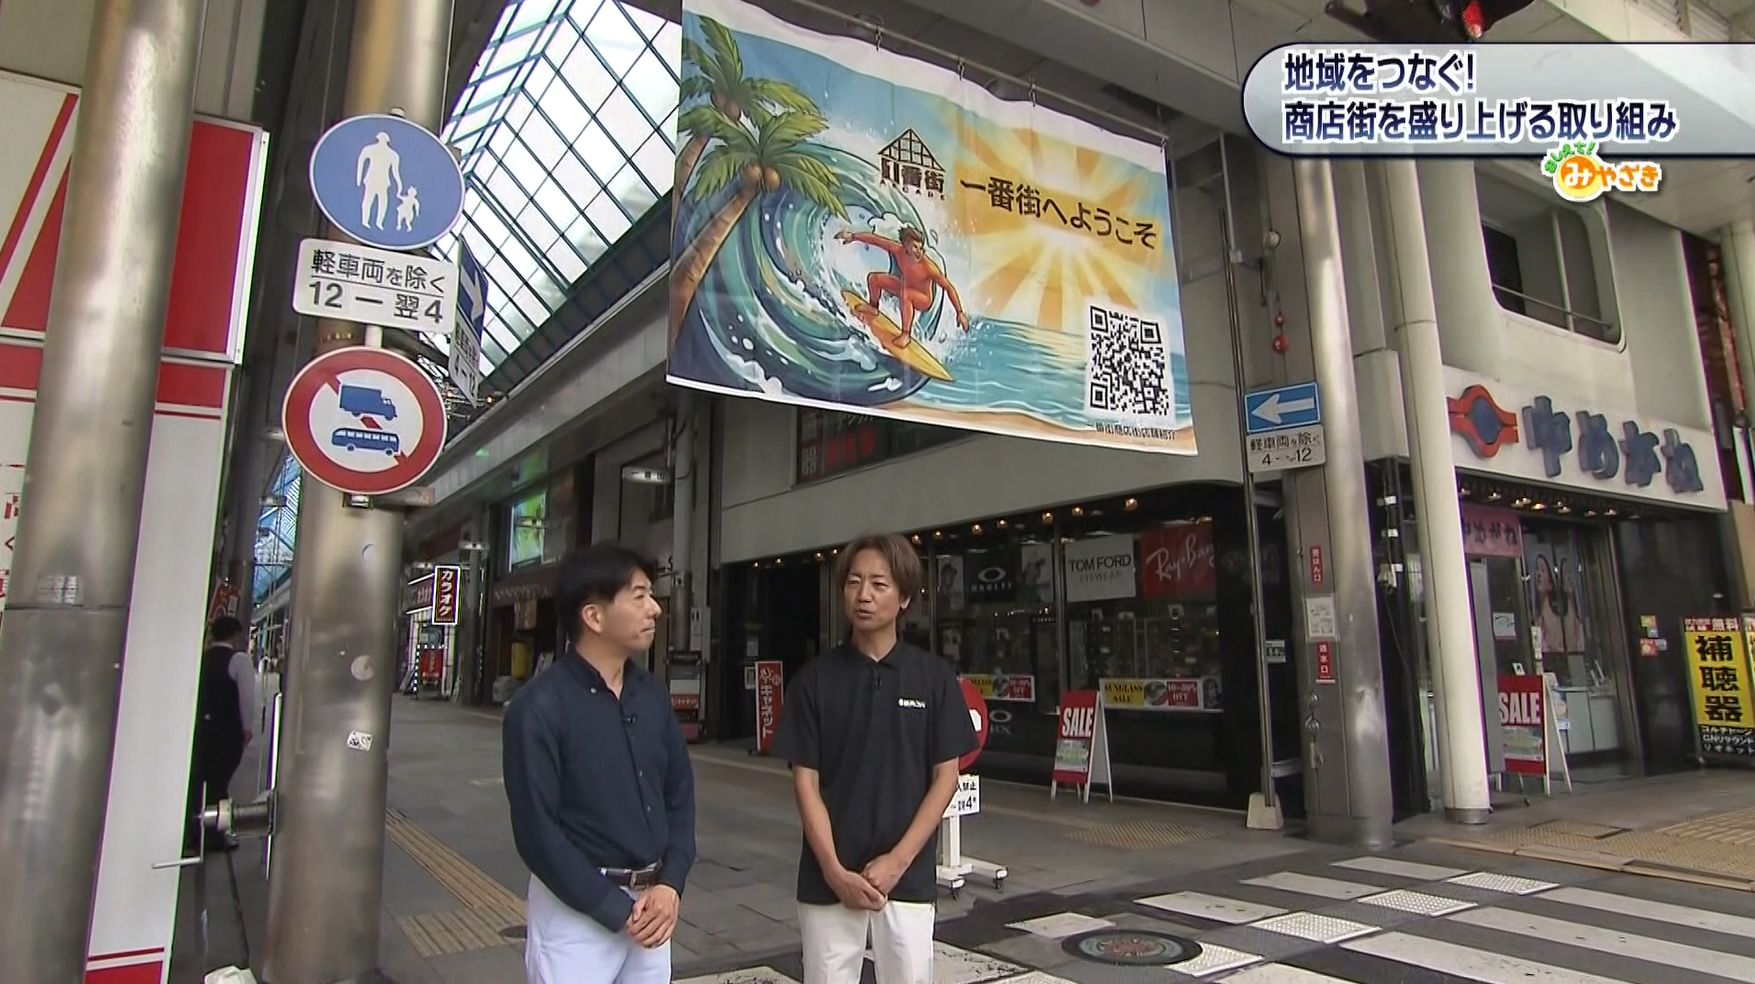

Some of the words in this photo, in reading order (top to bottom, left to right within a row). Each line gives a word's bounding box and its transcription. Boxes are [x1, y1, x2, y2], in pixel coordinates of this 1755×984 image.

[960, 176, 1157, 250] 一番街へようこそ
[311, 249, 445, 294] 軽車両を除く
[1069, 560, 1095, 572] TOM
[1096, 554, 1132, 569] FORD
[440, 569, 453, 617] カラオケ
[1695, 635, 1743, 723] 補聴器
[1062, 707, 1094, 738] SALE
[1500, 692, 1541, 724] SALE
